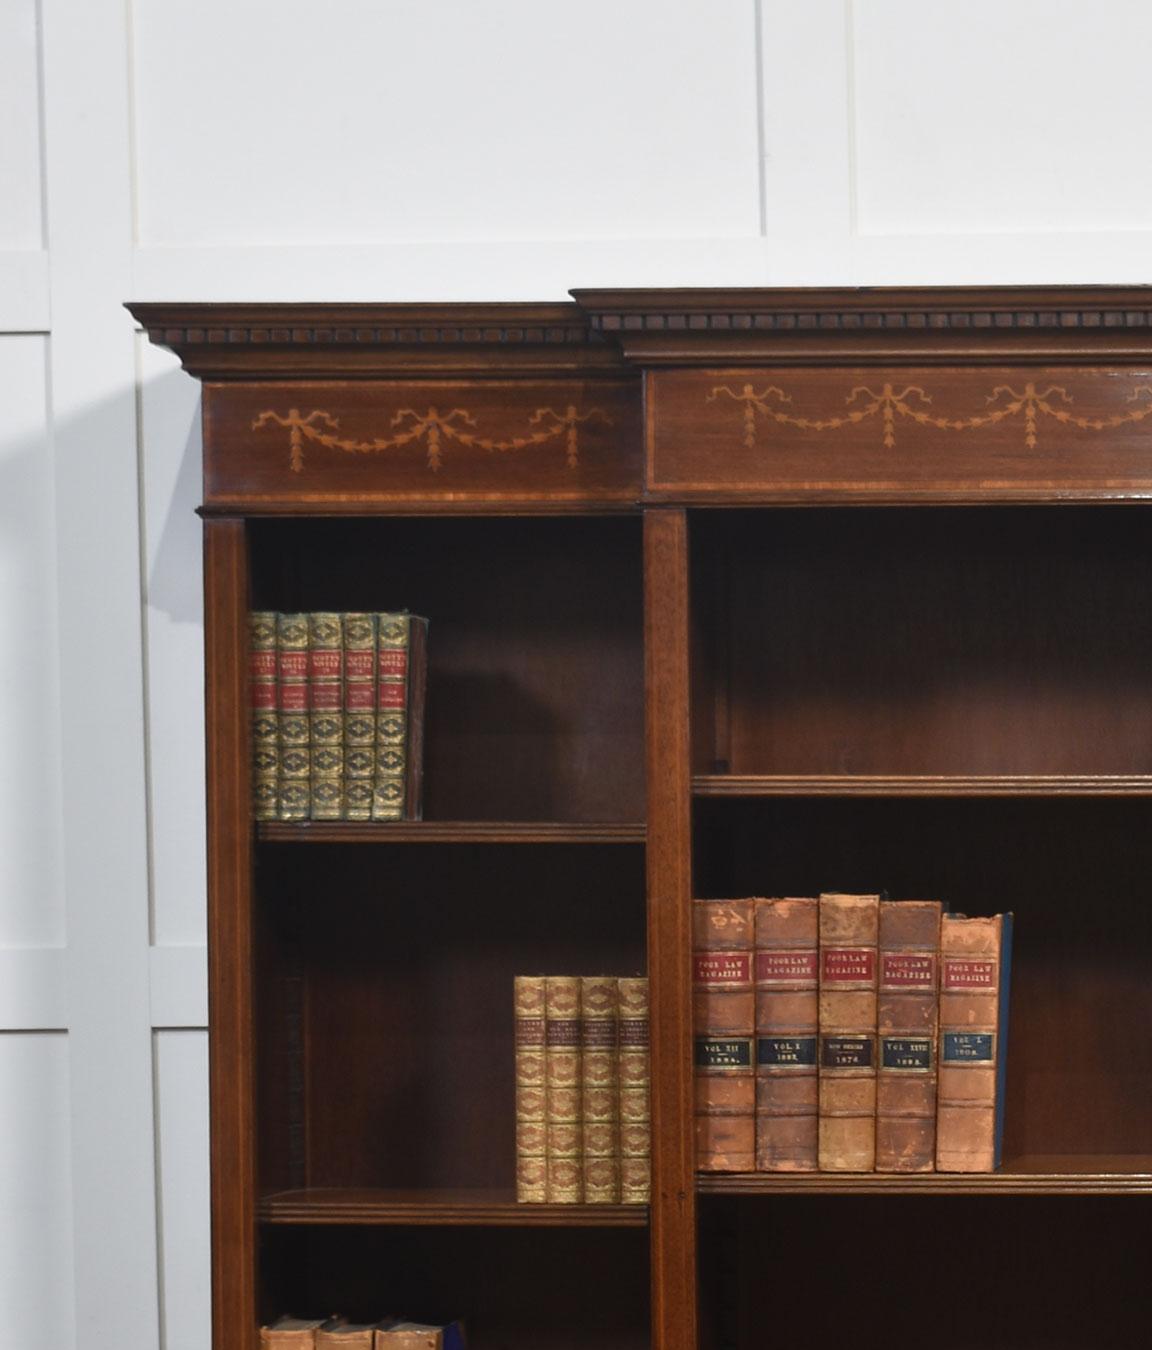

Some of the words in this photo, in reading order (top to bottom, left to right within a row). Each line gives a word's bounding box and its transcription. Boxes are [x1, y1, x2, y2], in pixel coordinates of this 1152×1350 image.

[790, 957, 809, 965] LAW
[849, 953, 868, 962] LAW
[973, 964, 991, 972] LAW
[885, 971, 932, 980] MAGAZINE
